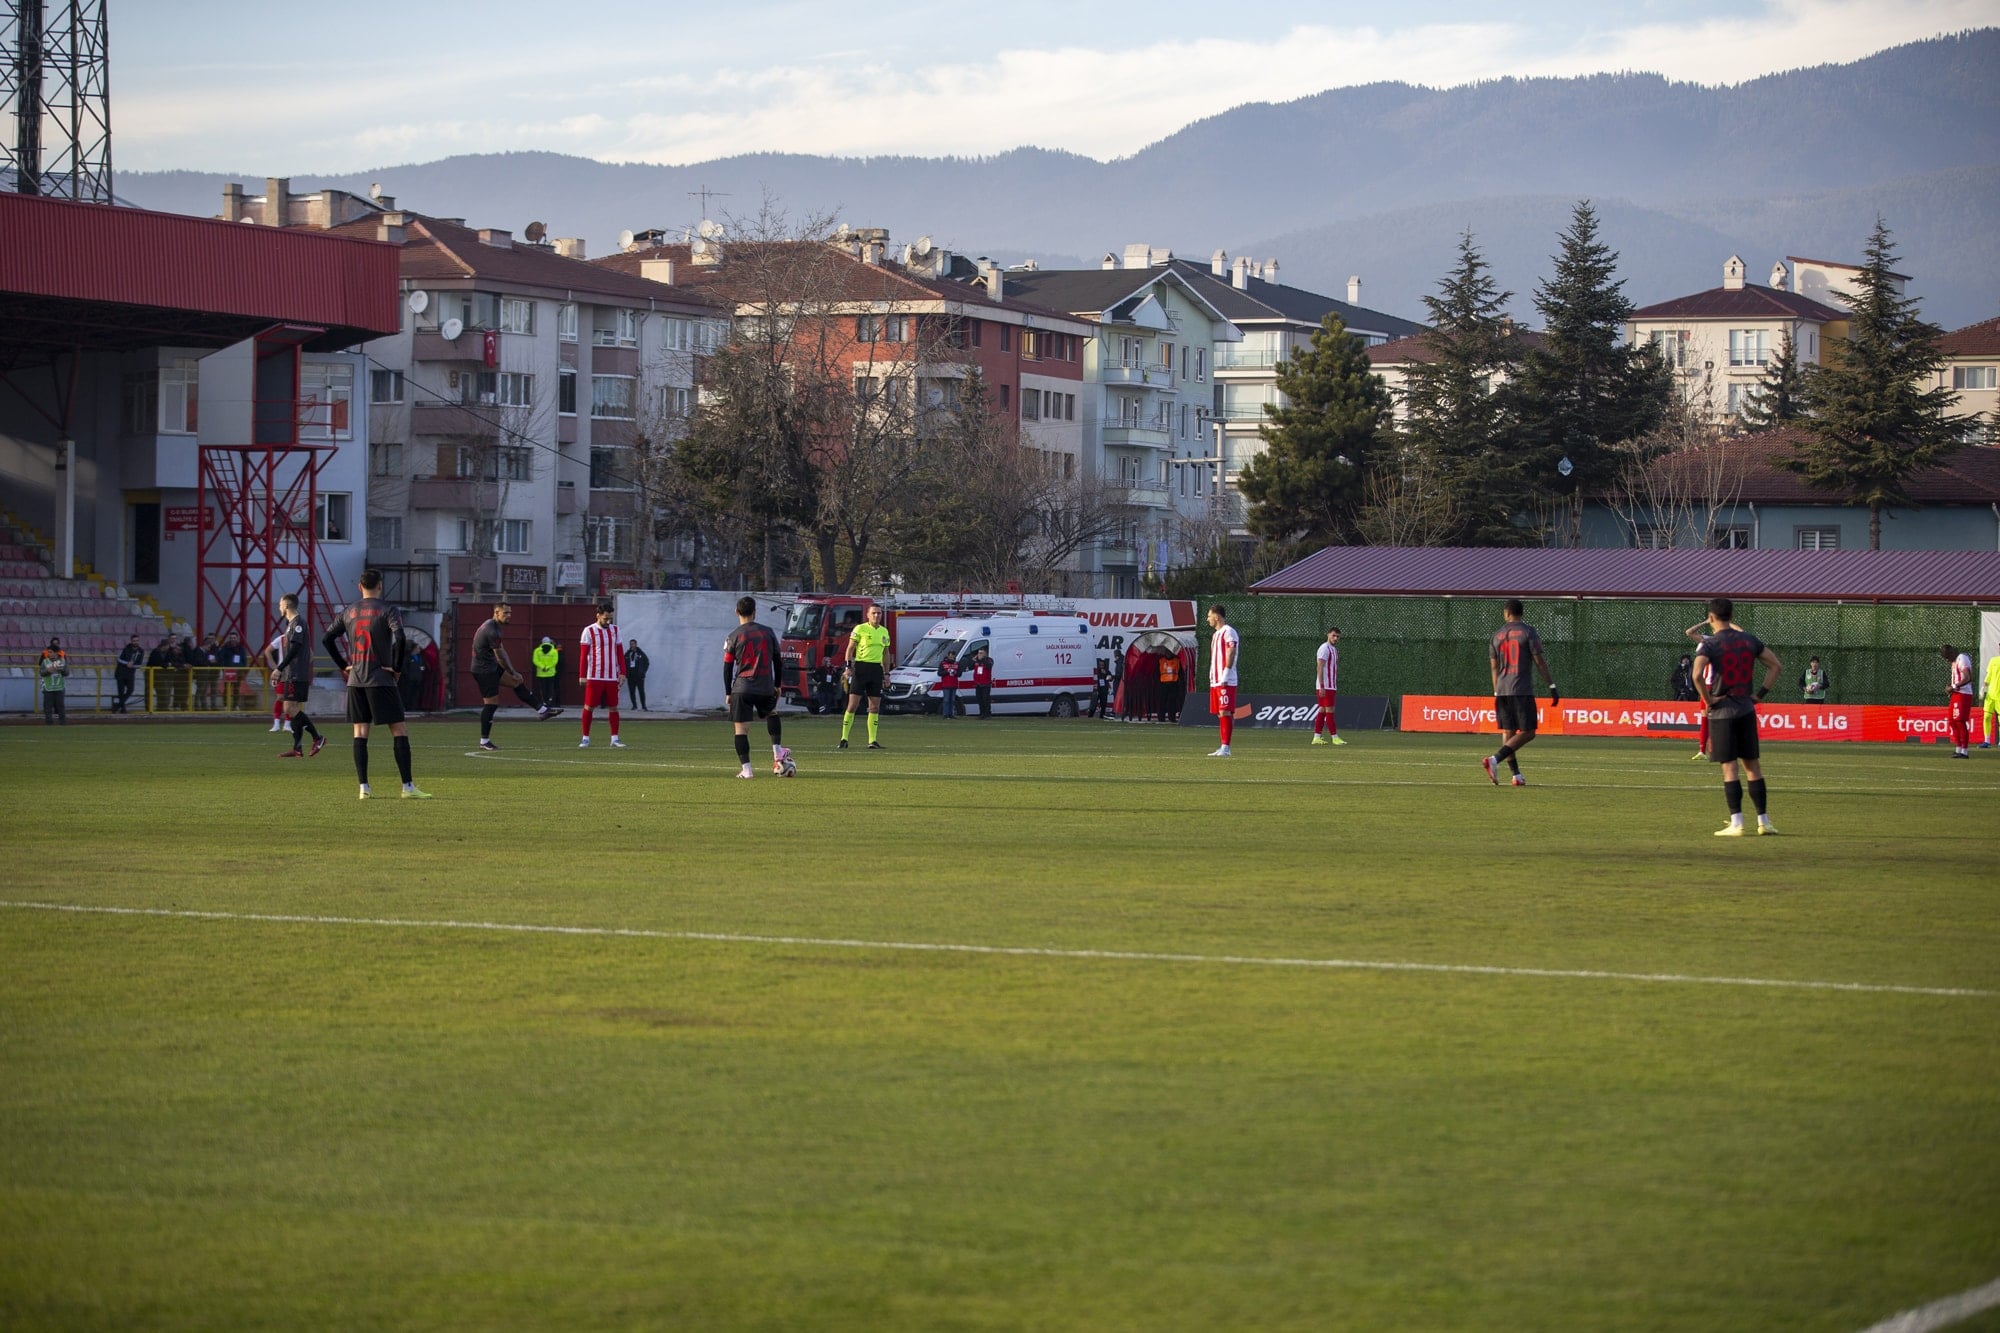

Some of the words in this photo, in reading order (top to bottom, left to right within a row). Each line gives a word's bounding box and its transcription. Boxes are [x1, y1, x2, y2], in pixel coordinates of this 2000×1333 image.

[513, 568, 538, 584] DERYA
[355, 619, 371, 651] 5
[1094, 635, 1124, 650] AR
[741, 639, 769, 668] 41
[1054, 653, 1072, 665] 112
[1500, 639, 1520, 666] 10
[1721, 650, 1754, 686] 88
[1006, 679, 1034, 687] AMBULANS
[1219, 695, 1229, 705] 10
[1255, 703, 1321, 725] arçeli
[1562, 709, 1614, 725] TBOL
[1618, 710, 1689, 727] AŞKINA
[1800, 714, 1812, 729] 1.
[1817, 712, 1848, 730] LİG
